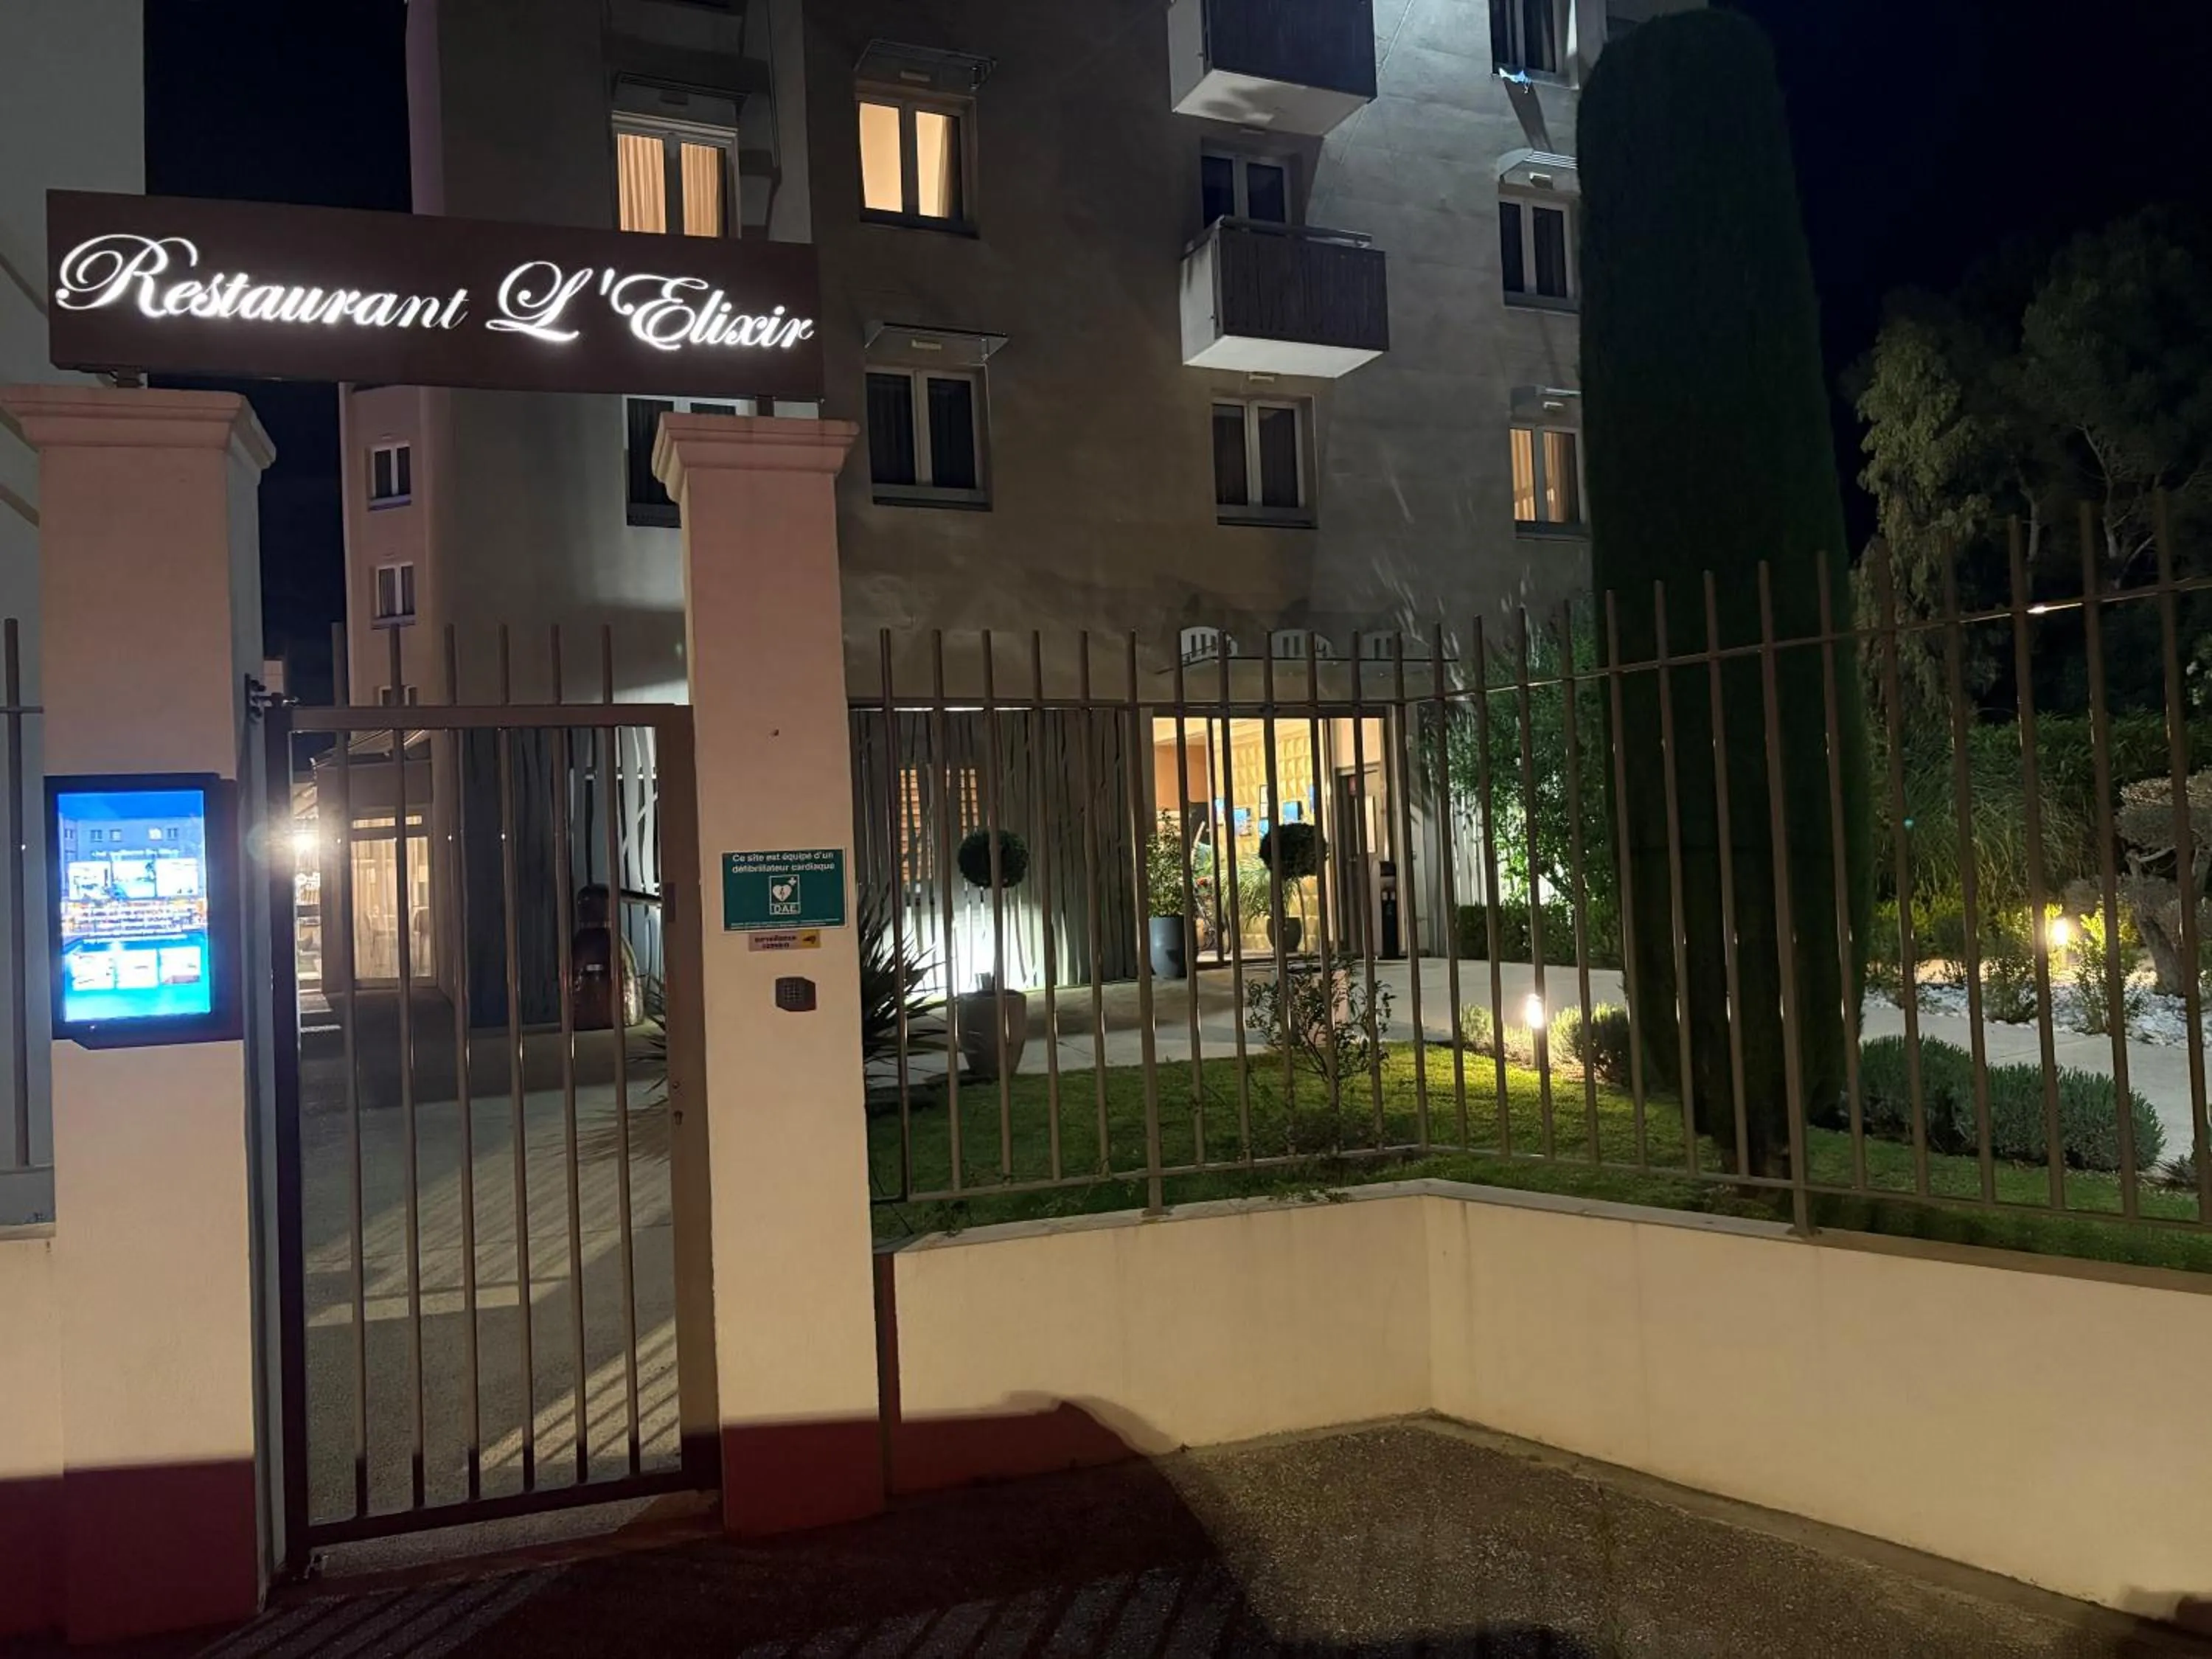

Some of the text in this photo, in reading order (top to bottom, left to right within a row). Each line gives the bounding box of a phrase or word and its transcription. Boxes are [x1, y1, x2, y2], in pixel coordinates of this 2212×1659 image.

[55, 233, 815, 352] Restaurant L'Elixir
[732, 854, 745, 862] Ce
[747, 853, 765, 862] site
[766, 853, 781, 861] est
[813, 851, 834, 860] d'un
[791, 862, 835, 872] cardiaque
